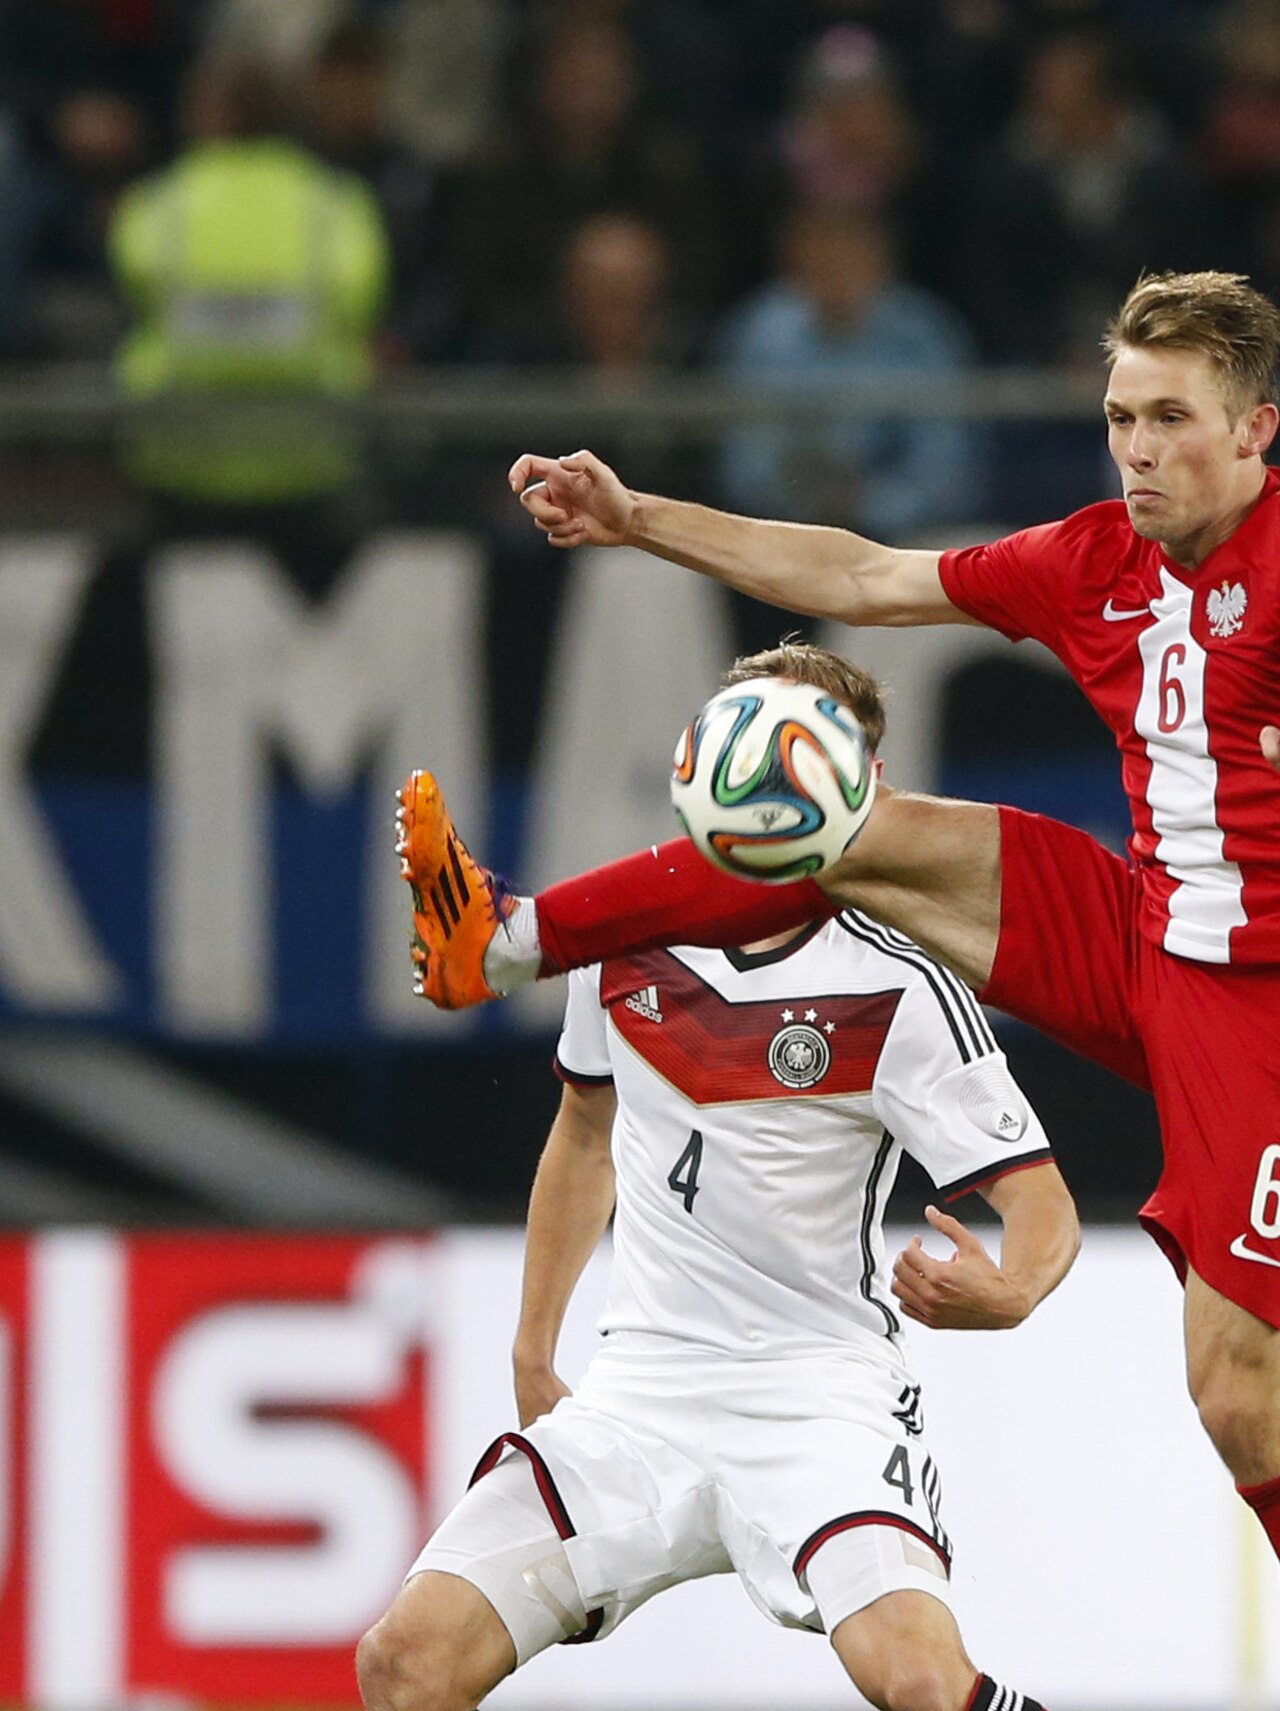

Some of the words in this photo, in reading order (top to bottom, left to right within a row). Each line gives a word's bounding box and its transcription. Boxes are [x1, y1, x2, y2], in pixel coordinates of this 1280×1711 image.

[1157, 643, 1187, 734] 6
[625, 997, 663, 1024] adidas
[668, 1129, 703, 1214] 4
[881, 1443, 915, 1507] 4
